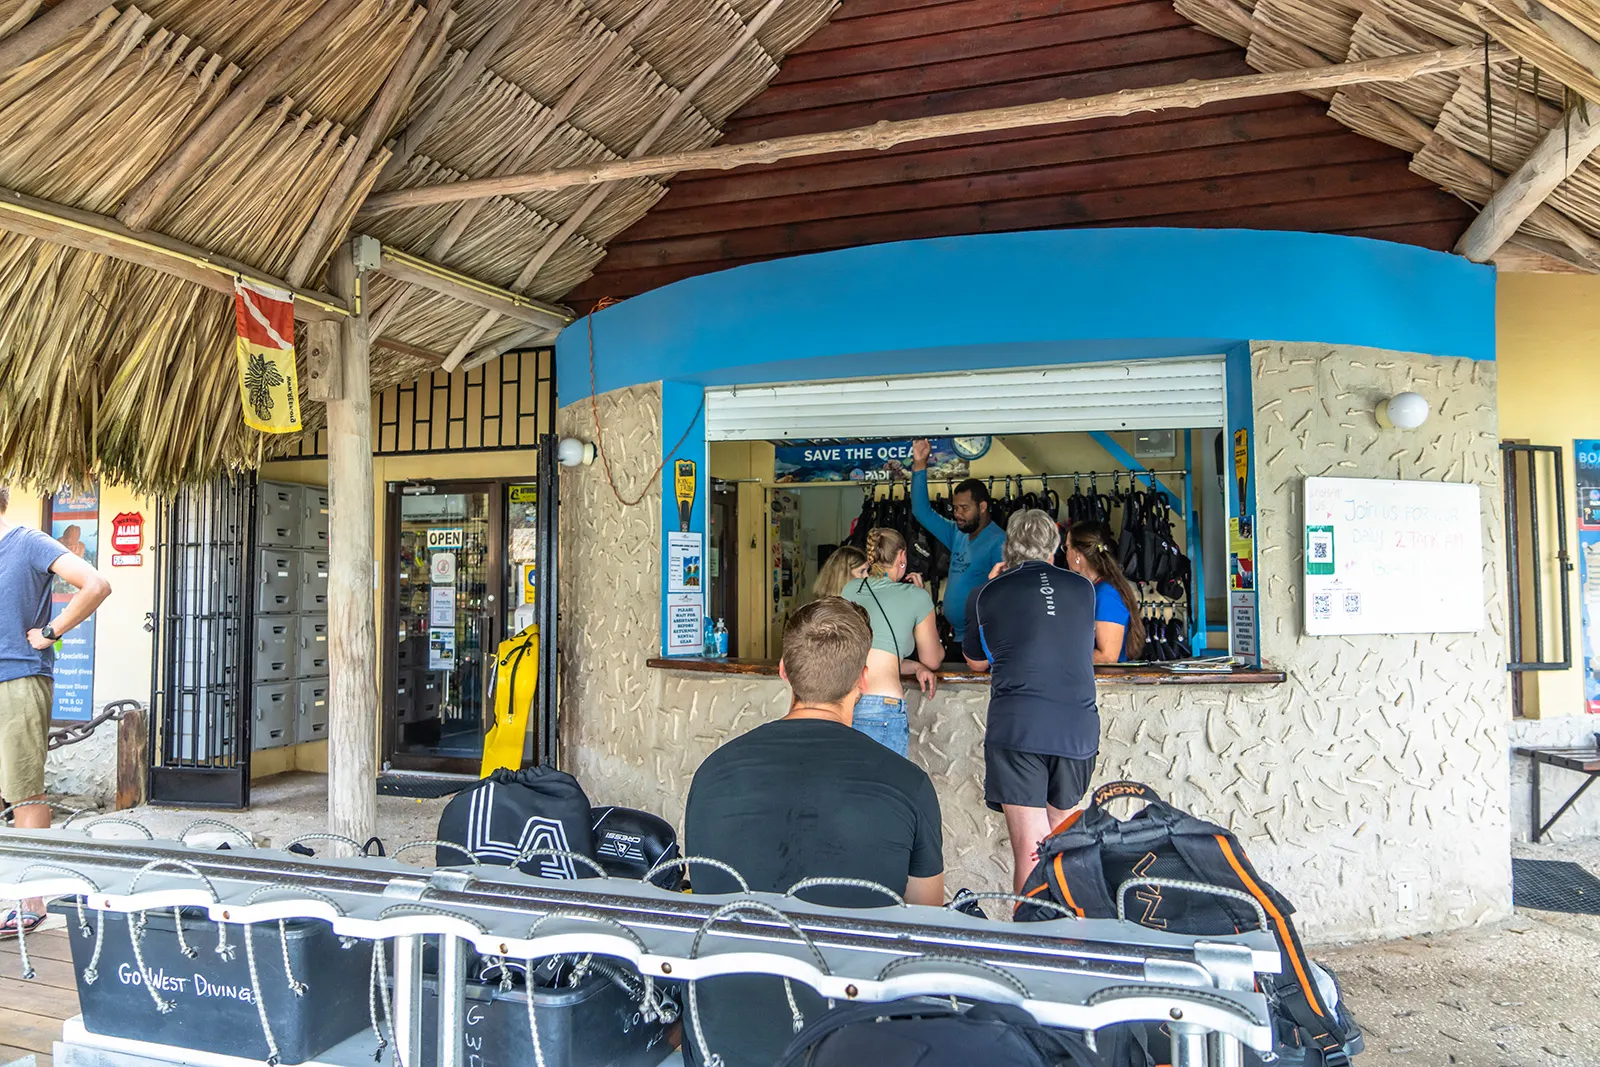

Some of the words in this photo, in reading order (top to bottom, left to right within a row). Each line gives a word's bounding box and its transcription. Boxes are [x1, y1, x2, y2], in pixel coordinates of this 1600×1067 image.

[804, 449, 840, 462] SAVE
[845, 448, 873, 459] THE
[877, 446, 914, 459] OCEA
[864, 471, 889, 480] PADI
[1344, 499, 1377, 521] Join
[117, 525, 139, 536] ALARM
[429, 532, 460, 546] OPEN
[1394, 531, 1406, 548] 2
[1045, 595, 1056, 616] AQUA
[62, 638, 86, 646] omplete:
[1095, 786, 1145, 806] AKONA
[605, 832, 641, 844] CRESSI
[148, 967, 191, 992] WEST
[194, 973, 257, 1004] DIVING
